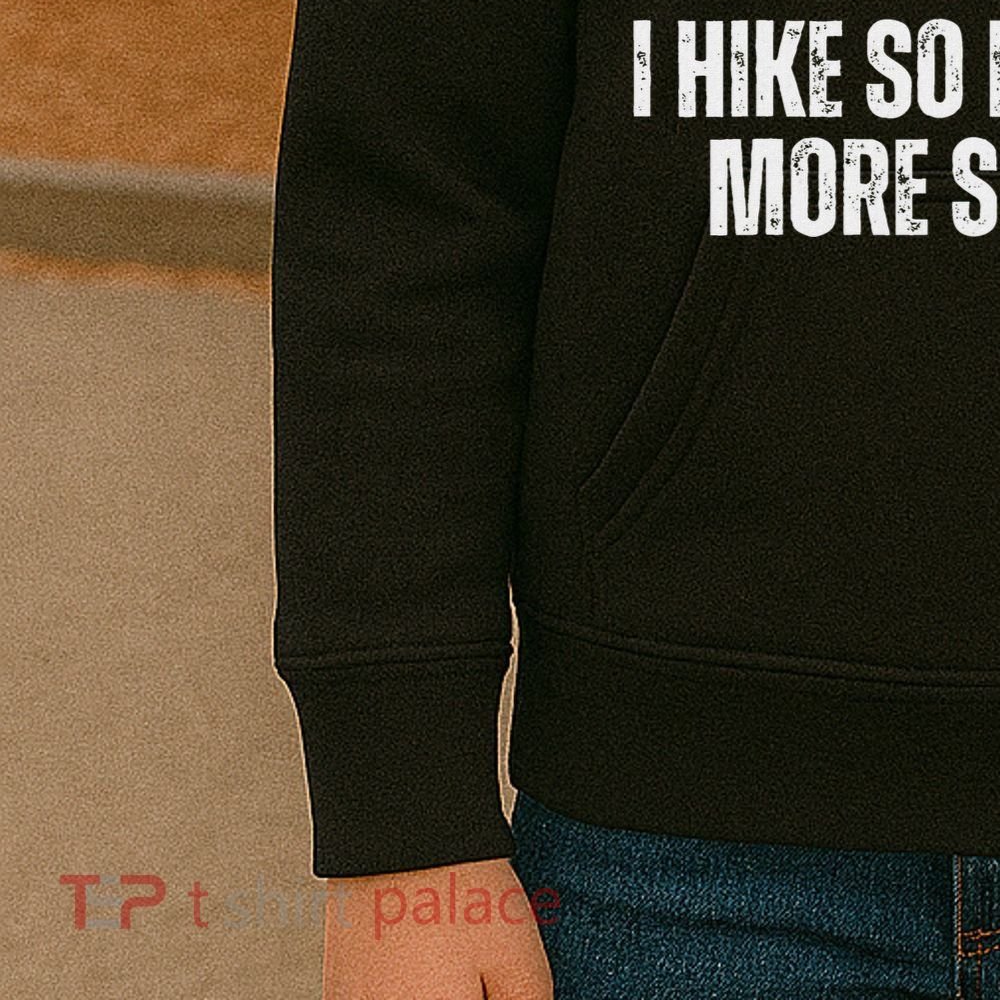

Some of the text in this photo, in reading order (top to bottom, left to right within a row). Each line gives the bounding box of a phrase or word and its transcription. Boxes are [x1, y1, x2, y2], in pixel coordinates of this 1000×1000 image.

[633, 19, 651, 118] I
[677, 19, 843, 118] HIKE
[866, 18, 963, 119] SO
[709, 137, 929, 237] MORE
